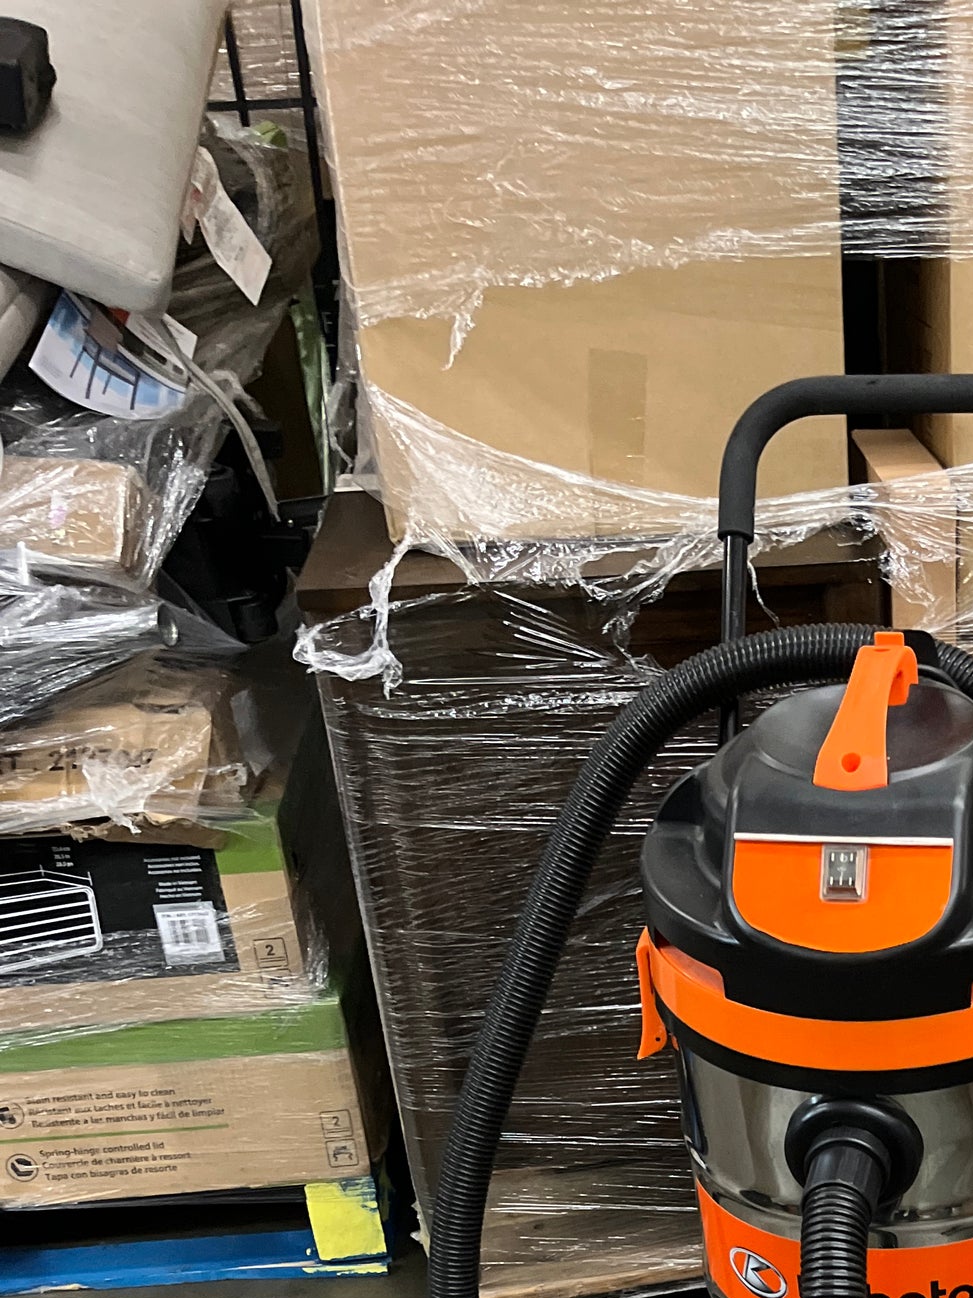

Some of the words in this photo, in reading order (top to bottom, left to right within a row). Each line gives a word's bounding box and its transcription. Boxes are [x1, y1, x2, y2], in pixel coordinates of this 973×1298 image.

[265, 944, 276, 956] 2
[52, 1093, 93, 1103] resistant
[95, 1090, 114, 1100] and
[115, 1091, 136, 1100] easy
[138, 1089, 149, 1098] to
[150, 1087, 176, 1097] clean
[93, 1102, 125, 1113] taches
[126, 1101, 136, 1110] et
[137, 1099, 163, 1109] facile
[172, 1097, 212, 1109] nettoyer
[106, 1111, 147, 1123] manchas
[156, 1110, 177, 1121] fácil
[178, 1109, 191, 1119] de
[192, 1107, 225, 1119] limpiar
[39, 1146, 100, 1159] Spring-hinge
[102, 1142, 150, 1154] controlled
[152, 1141, 165, 1150] lid
[91, 1156, 104, 1166] de
[105, 1153, 150, 1166] charnière
[159, 1151, 192, 1161] ressort
[45, 1172, 69, 1183] Tapa
[70, 1171, 88, 1180] con
[90, 1167, 130, 1180] bisagras
[131, 1165, 143, 1175] de
[144, 1163, 178, 1174] resorte
